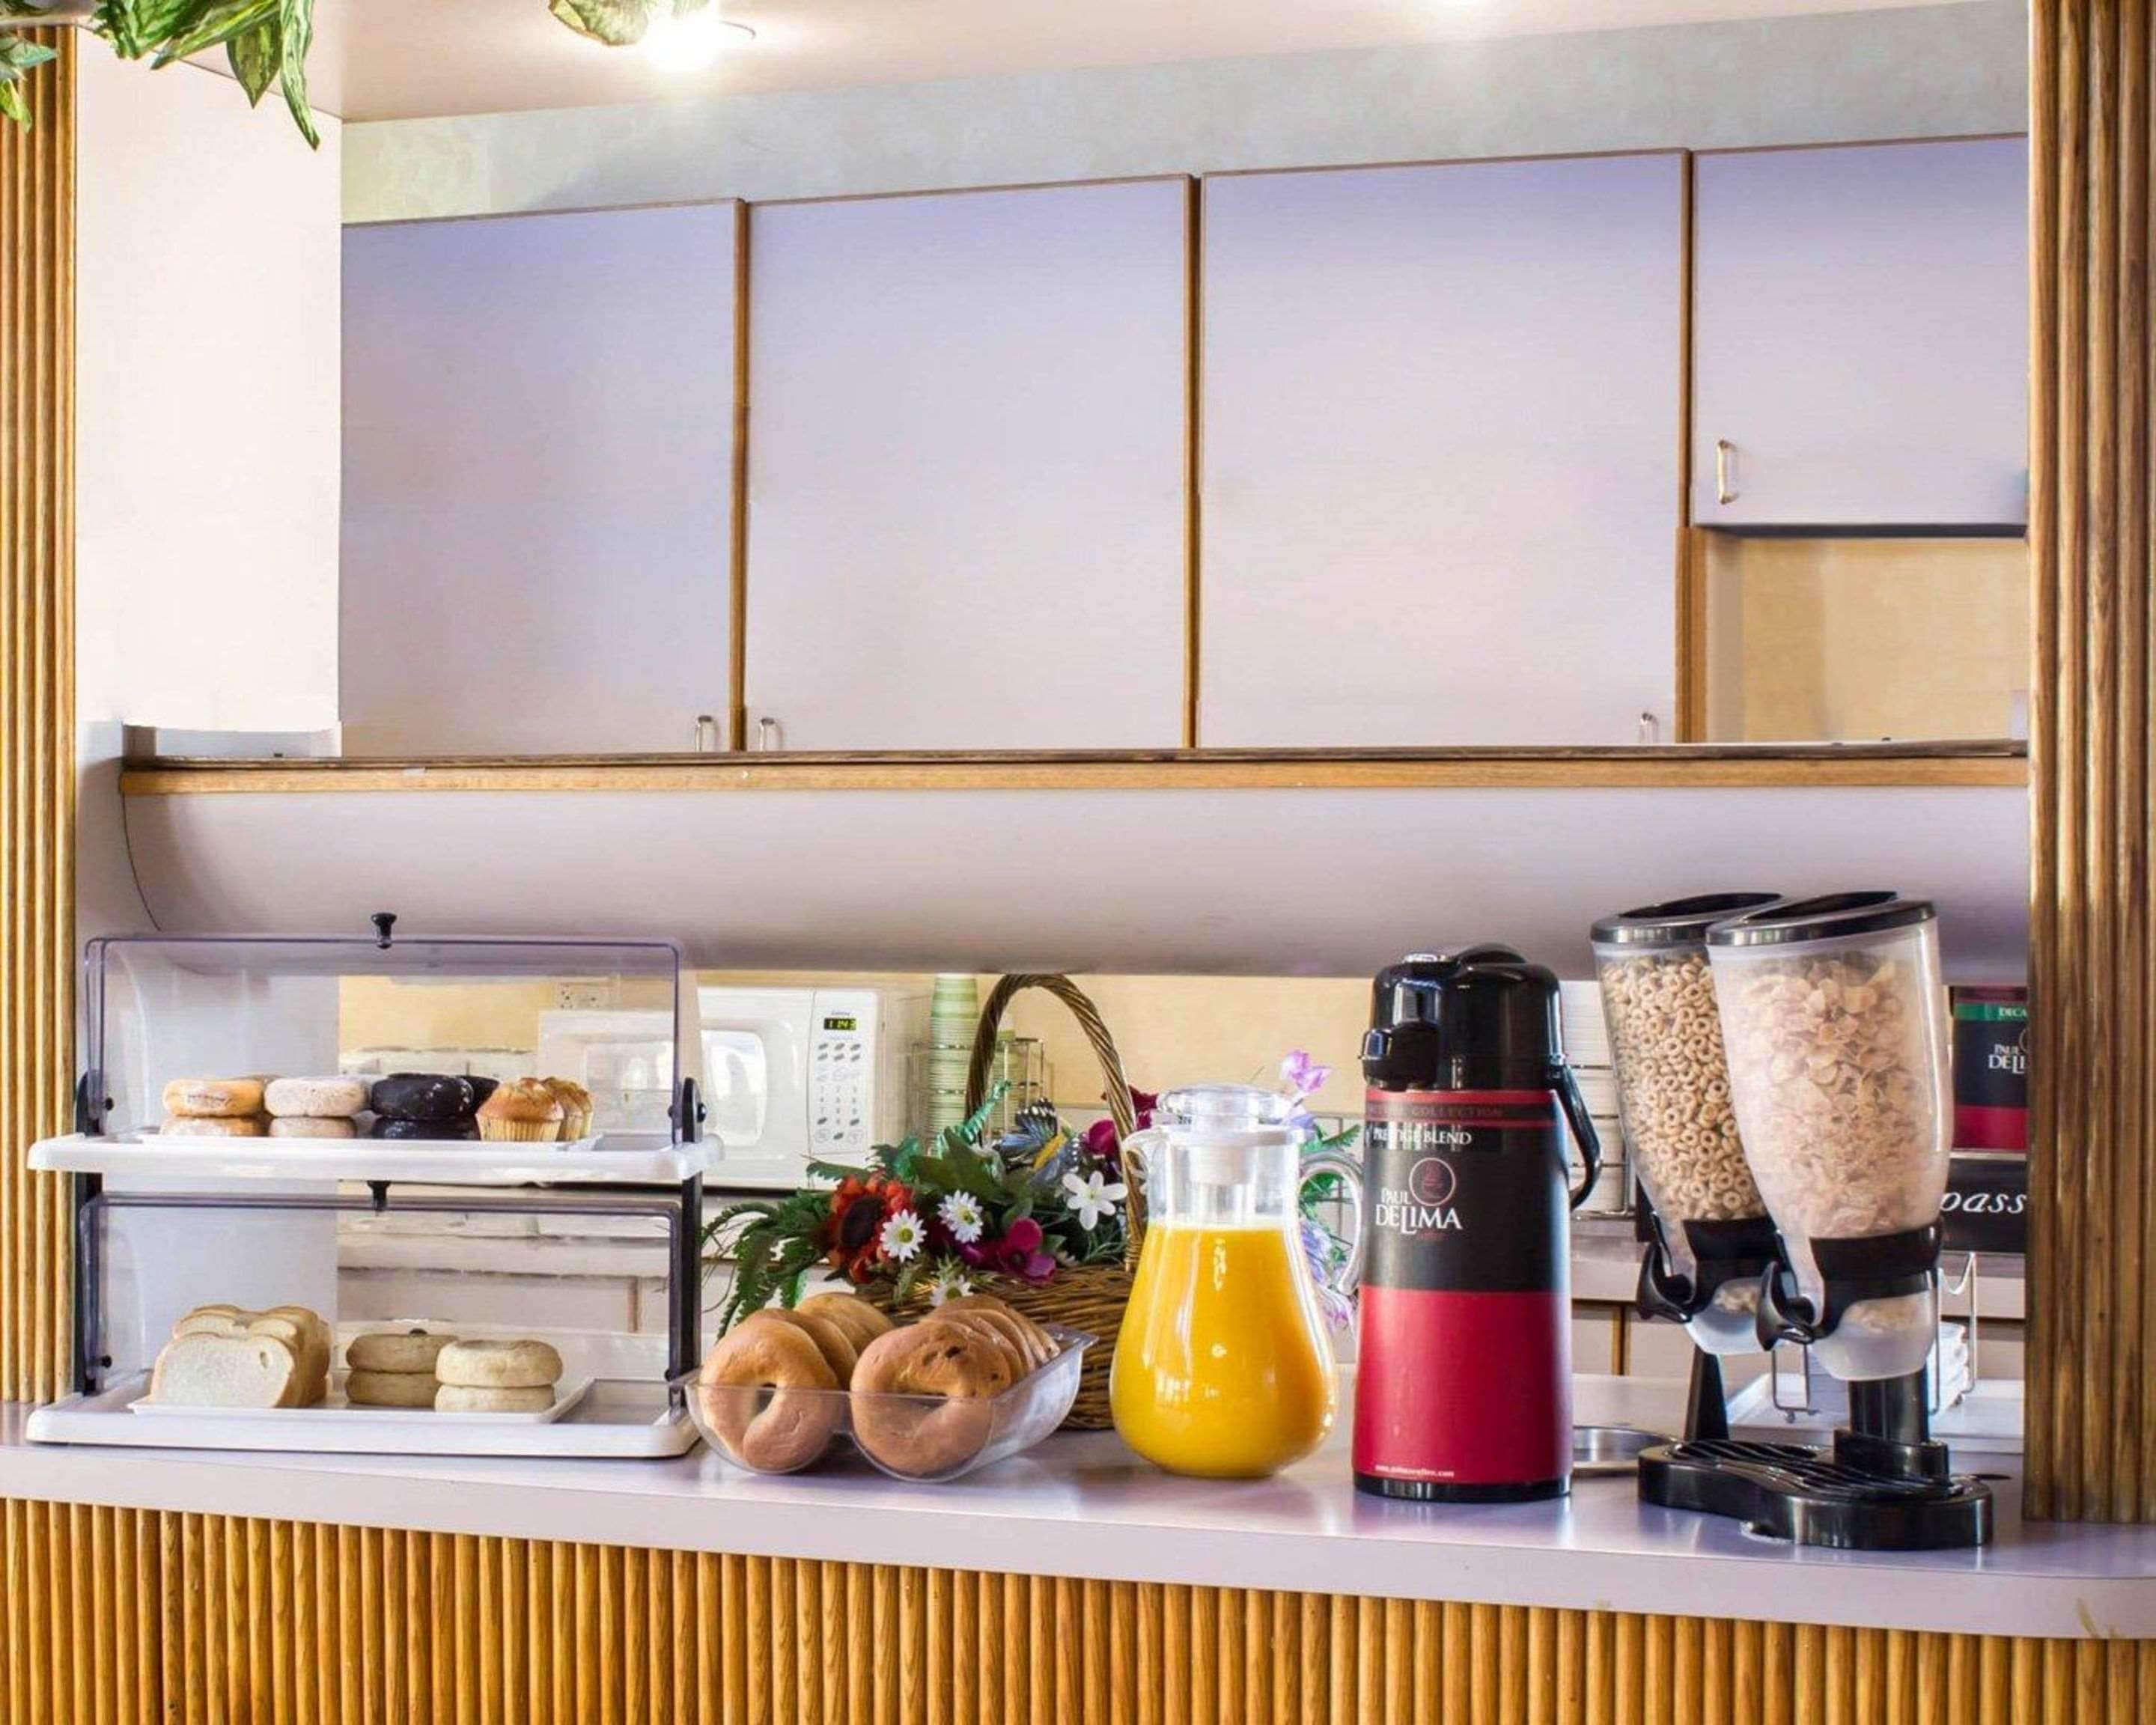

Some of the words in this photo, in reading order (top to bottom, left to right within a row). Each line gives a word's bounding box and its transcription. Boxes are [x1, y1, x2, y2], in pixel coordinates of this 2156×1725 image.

[1999, 1006, 2026, 1017] DECA
[1988, 1054, 2025, 1074] DELI
[1423, 1129, 1473, 1146] BLEND
[1381, 1187, 1412, 1205] PAUL
[1376, 1204, 1464, 1235] DELIMA
